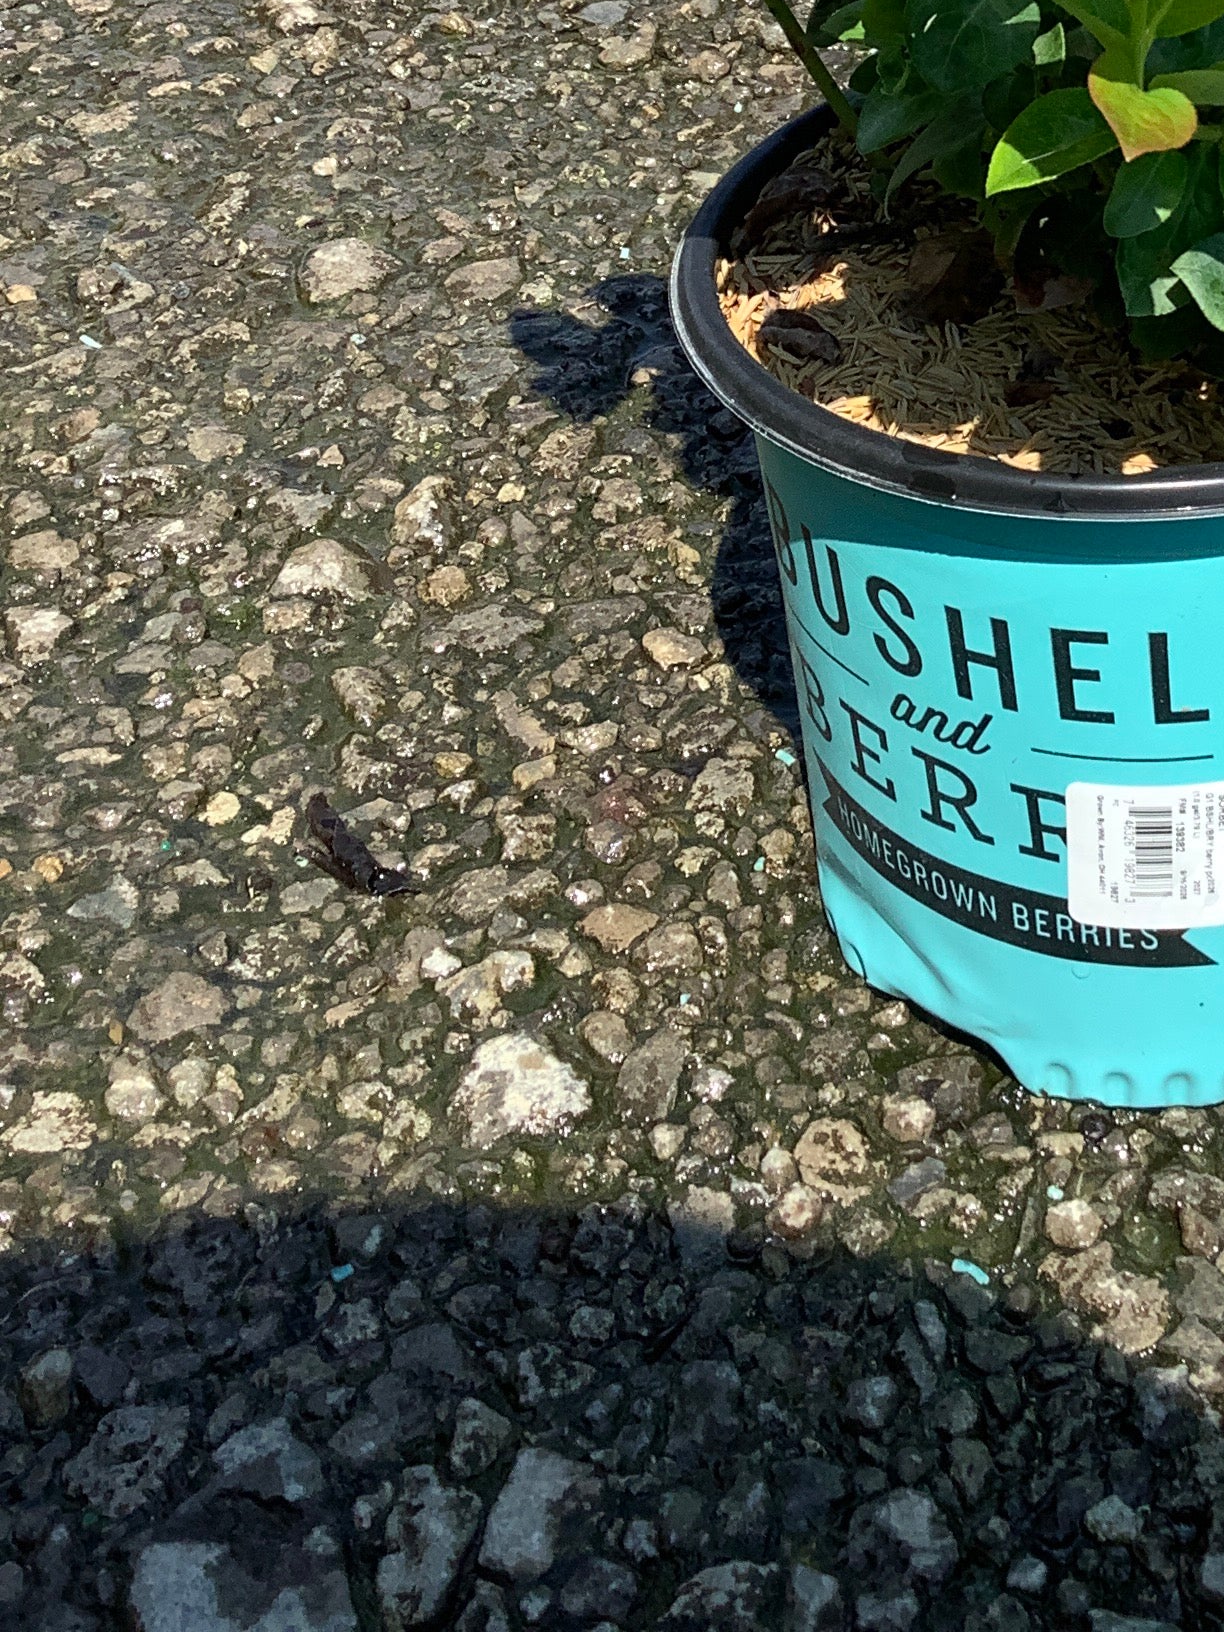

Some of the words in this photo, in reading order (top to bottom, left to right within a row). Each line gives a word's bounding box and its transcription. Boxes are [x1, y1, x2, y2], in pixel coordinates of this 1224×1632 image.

[766, 480, 1211, 726] BUSHEL
[799, 645, 1067, 863] BERR
[890, 693, 992, 756] and
[836, 795, 998, 924] HOMEGROWN
[1012, 902, 1159, 952] BERRIES
